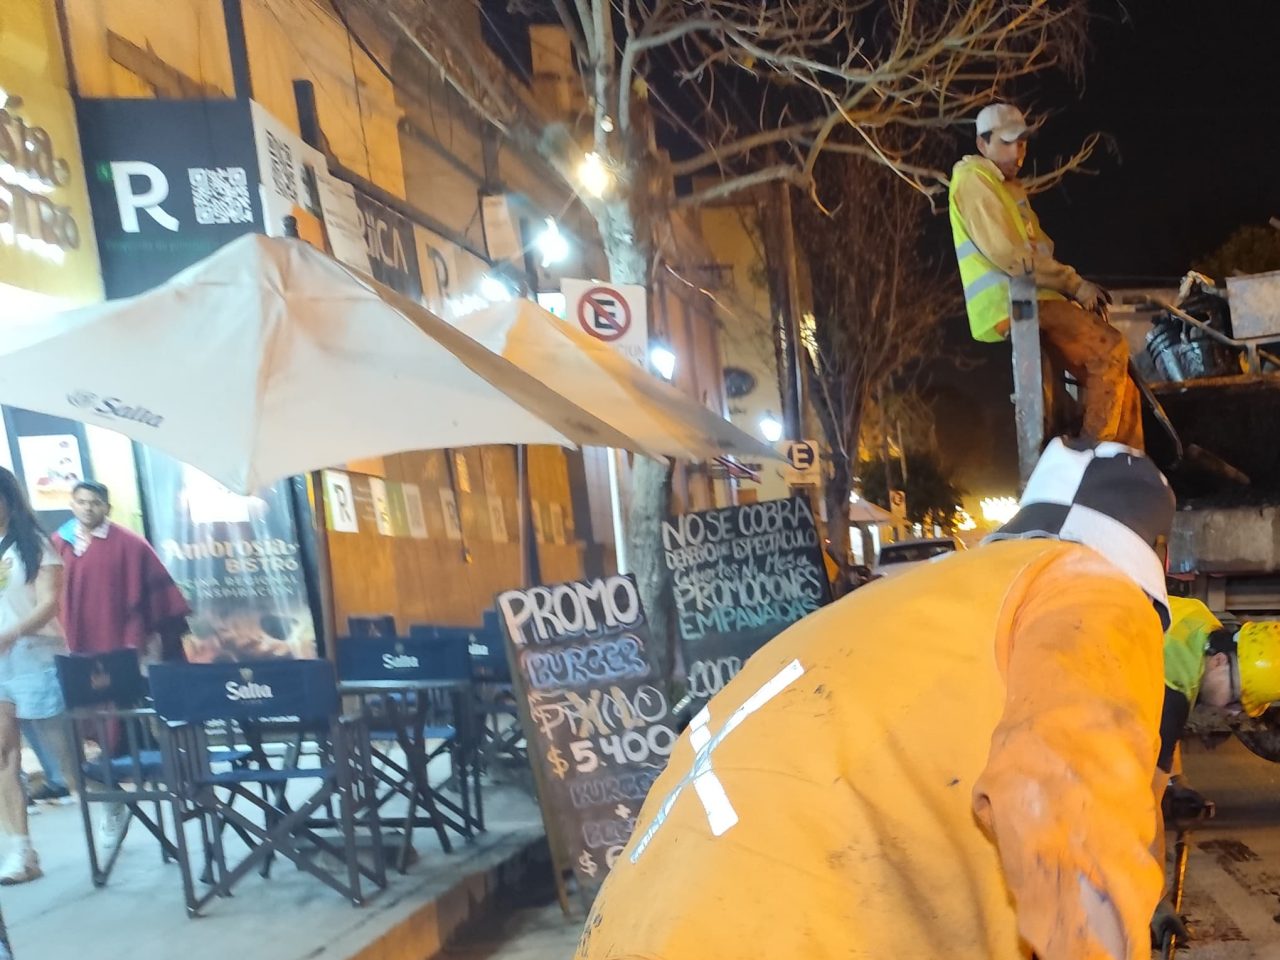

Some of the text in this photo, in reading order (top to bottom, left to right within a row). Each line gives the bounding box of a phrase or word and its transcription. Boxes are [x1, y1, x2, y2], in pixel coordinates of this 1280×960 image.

[110, 160, 180, 233] R
[792, 443, 811, 469] E
[662, 512, 705, 551] NO
[739, 496, 815, 536] COBRA
[499, 576, 640, 643] PROMO
[679, 597, 820, 640] EMPANADAS
